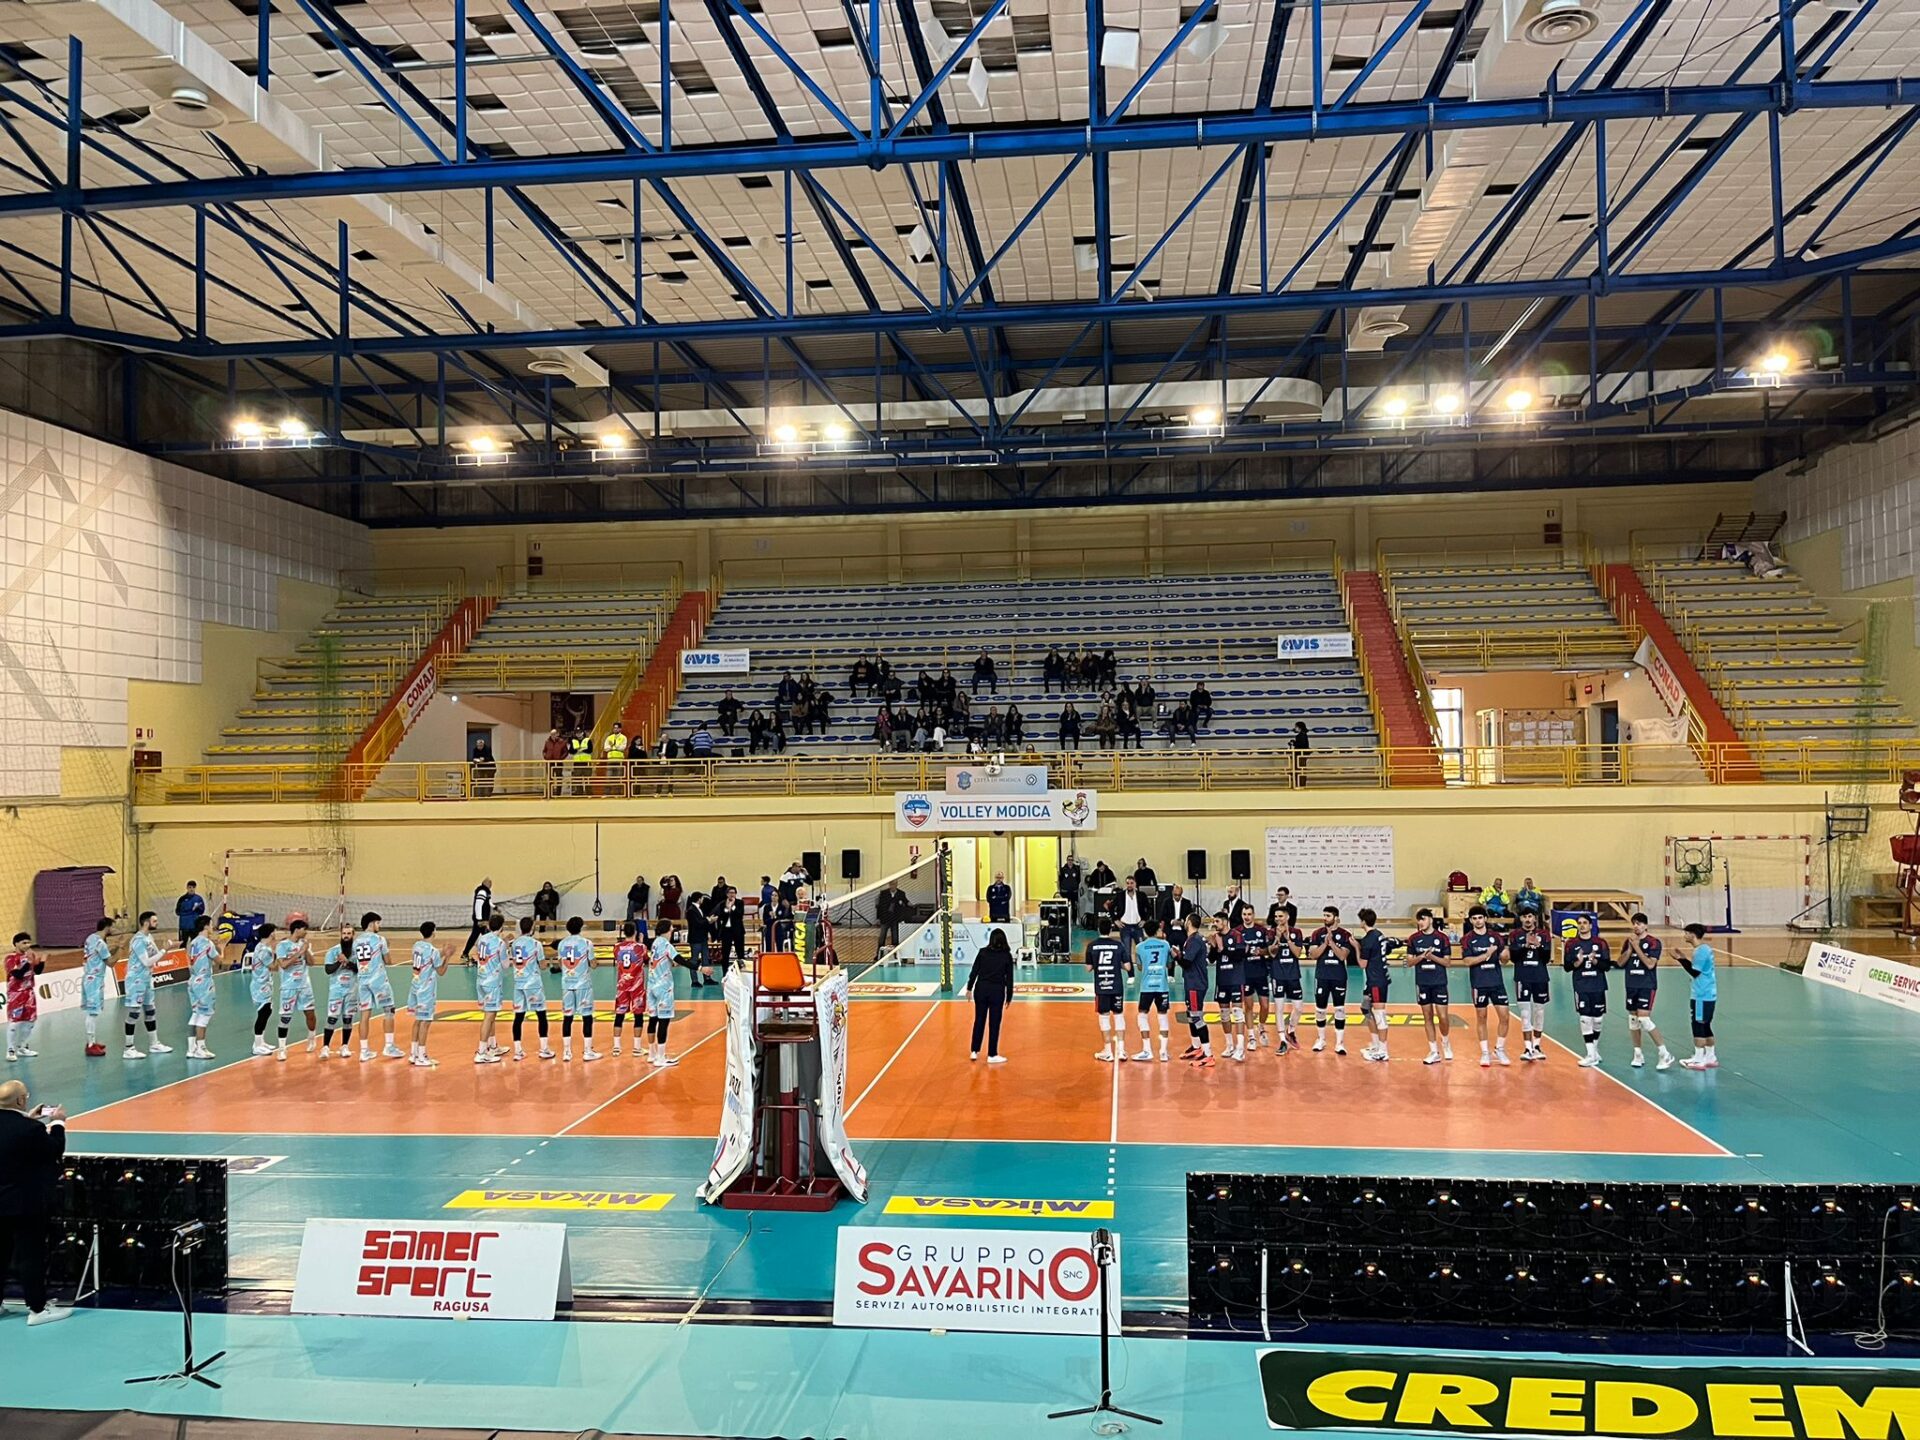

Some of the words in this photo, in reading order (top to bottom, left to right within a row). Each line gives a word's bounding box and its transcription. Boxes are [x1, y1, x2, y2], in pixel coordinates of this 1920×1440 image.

[1281, 639, 1319, 650] AVIS
[684, 654, 720, 664] AVIS
[1654, 657, 1680, 702] CONAD
[407, 666, 435, 708] CONAD
[940, 805, 992, 818] VOLLEY
[996, 805, 1051, 818] MODICA
[794, 922, 807, 963] ANCA
[357, 945, 371, 960] 22
[515, 949, 523, 963] 2
[567, 949, 575, 963] 4
[1098, 950, 1113, 964] 12
[1150, 951, 1159, 964] 3
[1526, 950, 1534, 958] 9
[622, 953, 631, 967] 8
[1632, 959, 1640, 967] 4
[1831, 954, 1856, 968] REALE
[1869, 968, 1893, 985] GREEN
[1893, 975, 1920, 992] SERVIC
[897, 1245, 1044, 1265] GRUPPO
[857, 1242, 1099, 1301] SAVARINO
[1063, 1270, 1083, 1279] SNC
[433, 1301, 489, 1312] RAGUSA
[856, 1300, 905, 1310] SERVIZI
[912, 1303, 1025, 1314] AUTOMOBILISTICI
[1031, 1306, 1100, 1317] INTEGRATI
[1306, 1369, 1920, 1440] CREDEM
